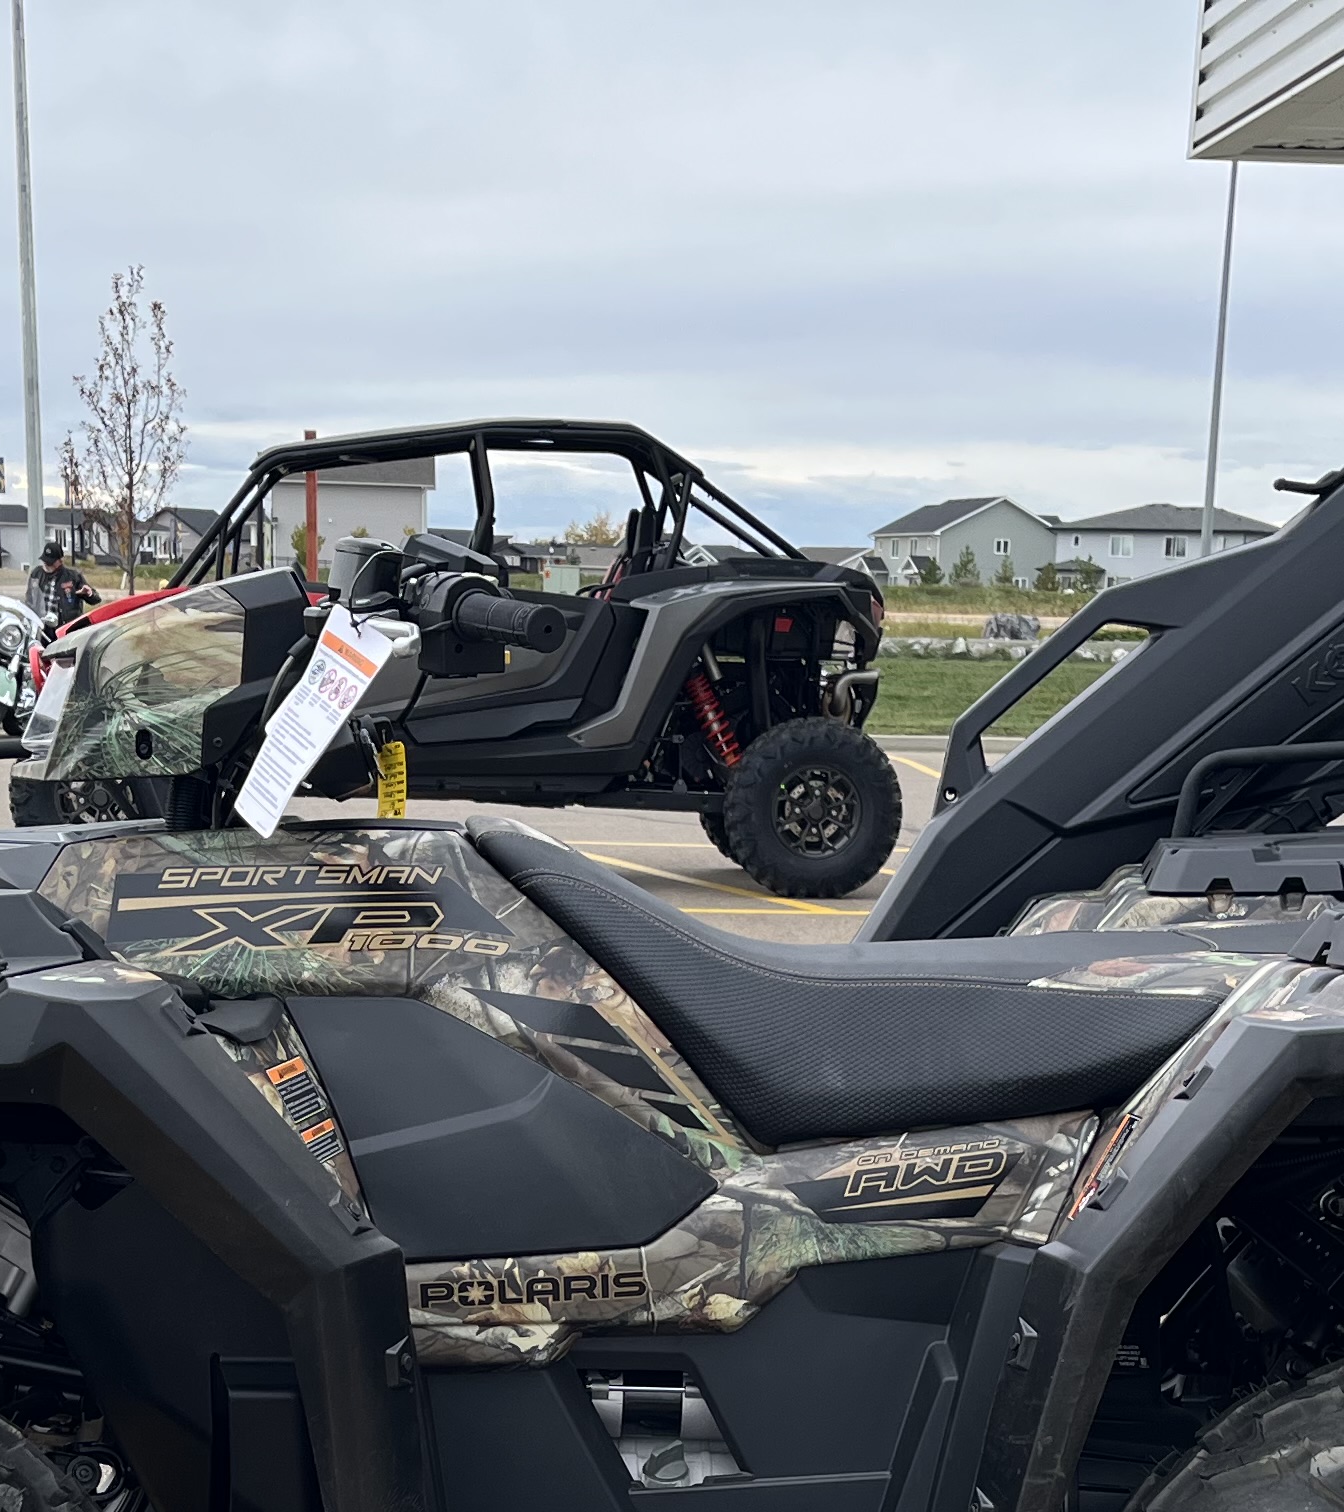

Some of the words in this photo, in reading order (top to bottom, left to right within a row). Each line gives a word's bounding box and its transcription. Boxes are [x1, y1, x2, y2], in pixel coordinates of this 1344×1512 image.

[158, 864, 445, 889] SPORTSMAN
[156, 901, 444, 956] XP
[347, 932, 510, 957] 1000
[857, 1153, 892, 1167] ON
[900, 1139, 1001, 1161] DEMAND
[844, 1151, 1007, 1197] AWD
[419, 1271, 647, 1309] POLARIS
